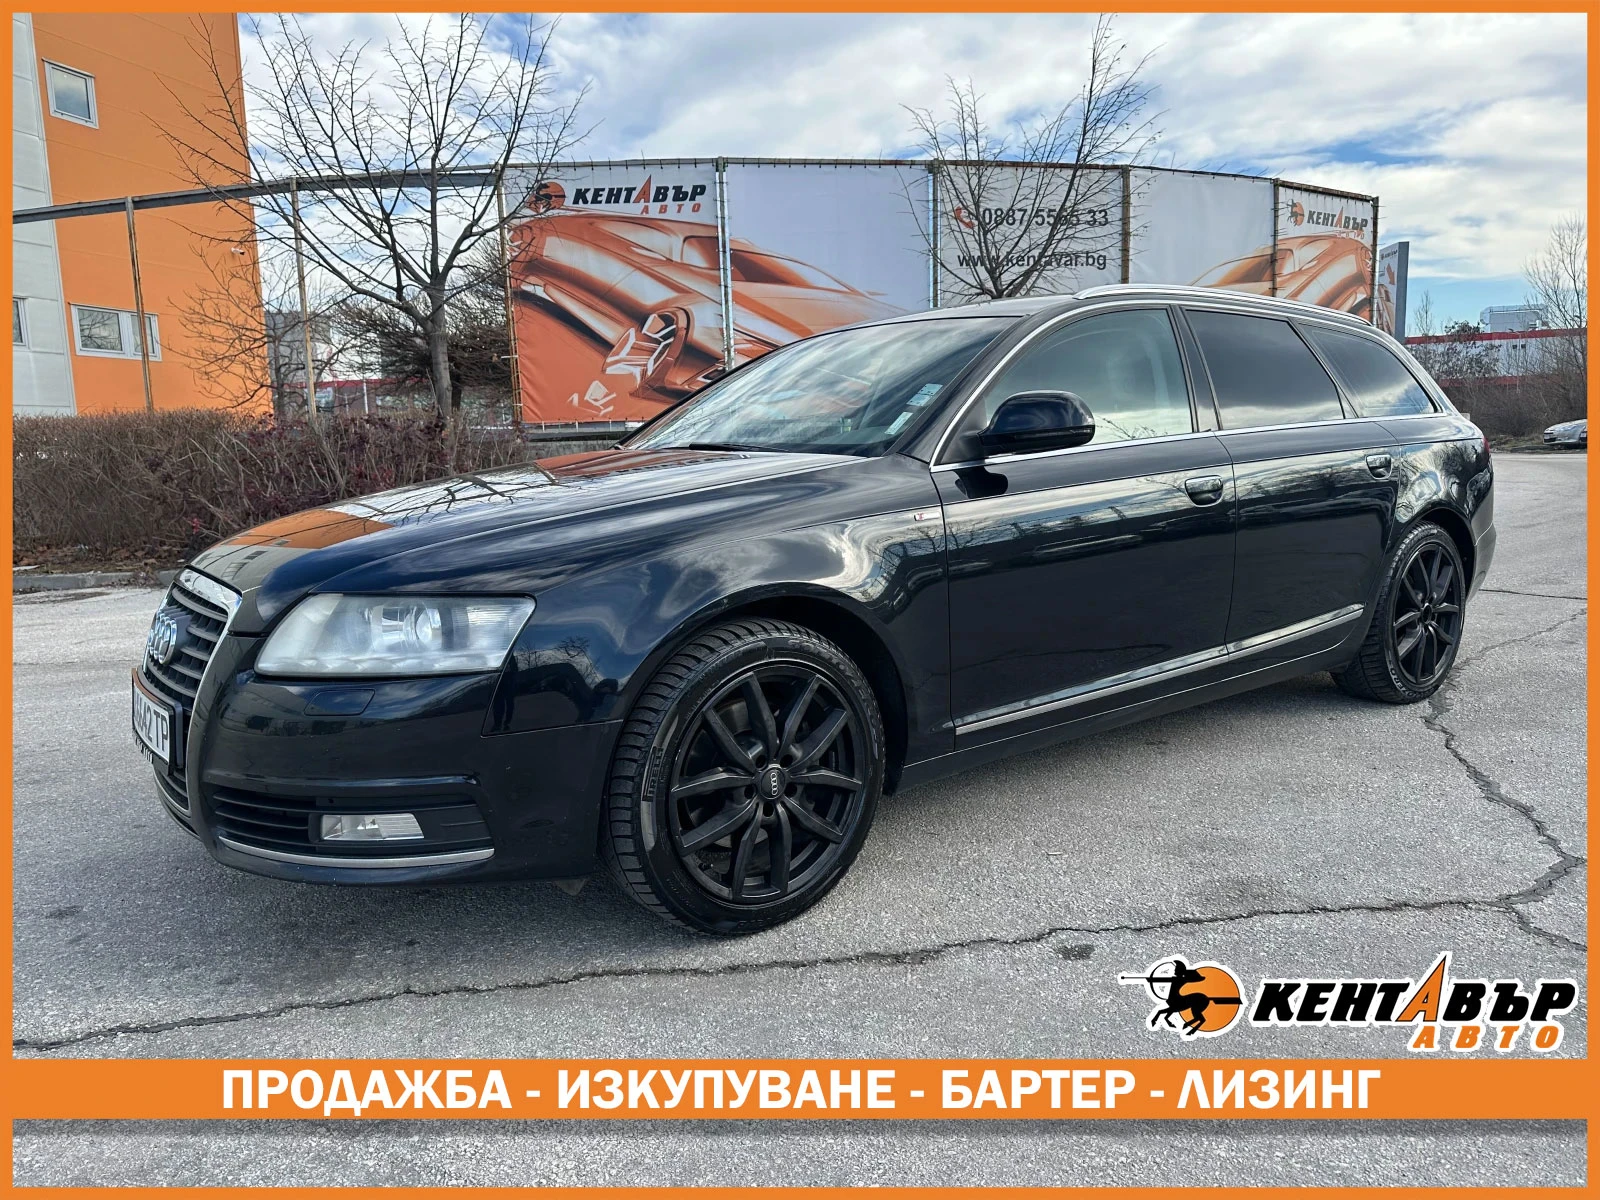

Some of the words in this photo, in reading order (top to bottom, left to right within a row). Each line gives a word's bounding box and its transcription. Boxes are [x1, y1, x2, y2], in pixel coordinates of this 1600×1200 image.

[572, 174, 707, 205] КЕНТАВЪР
[640, 203, 702, 215] АВТО
[982, 207, 1028, 227] 0887
[1086, 208, 1109, 227] 33
[1307, 206, 1368, 231] КЕНТАВЪР
[957, 250, 1107, 271] www.kenavar.bg
